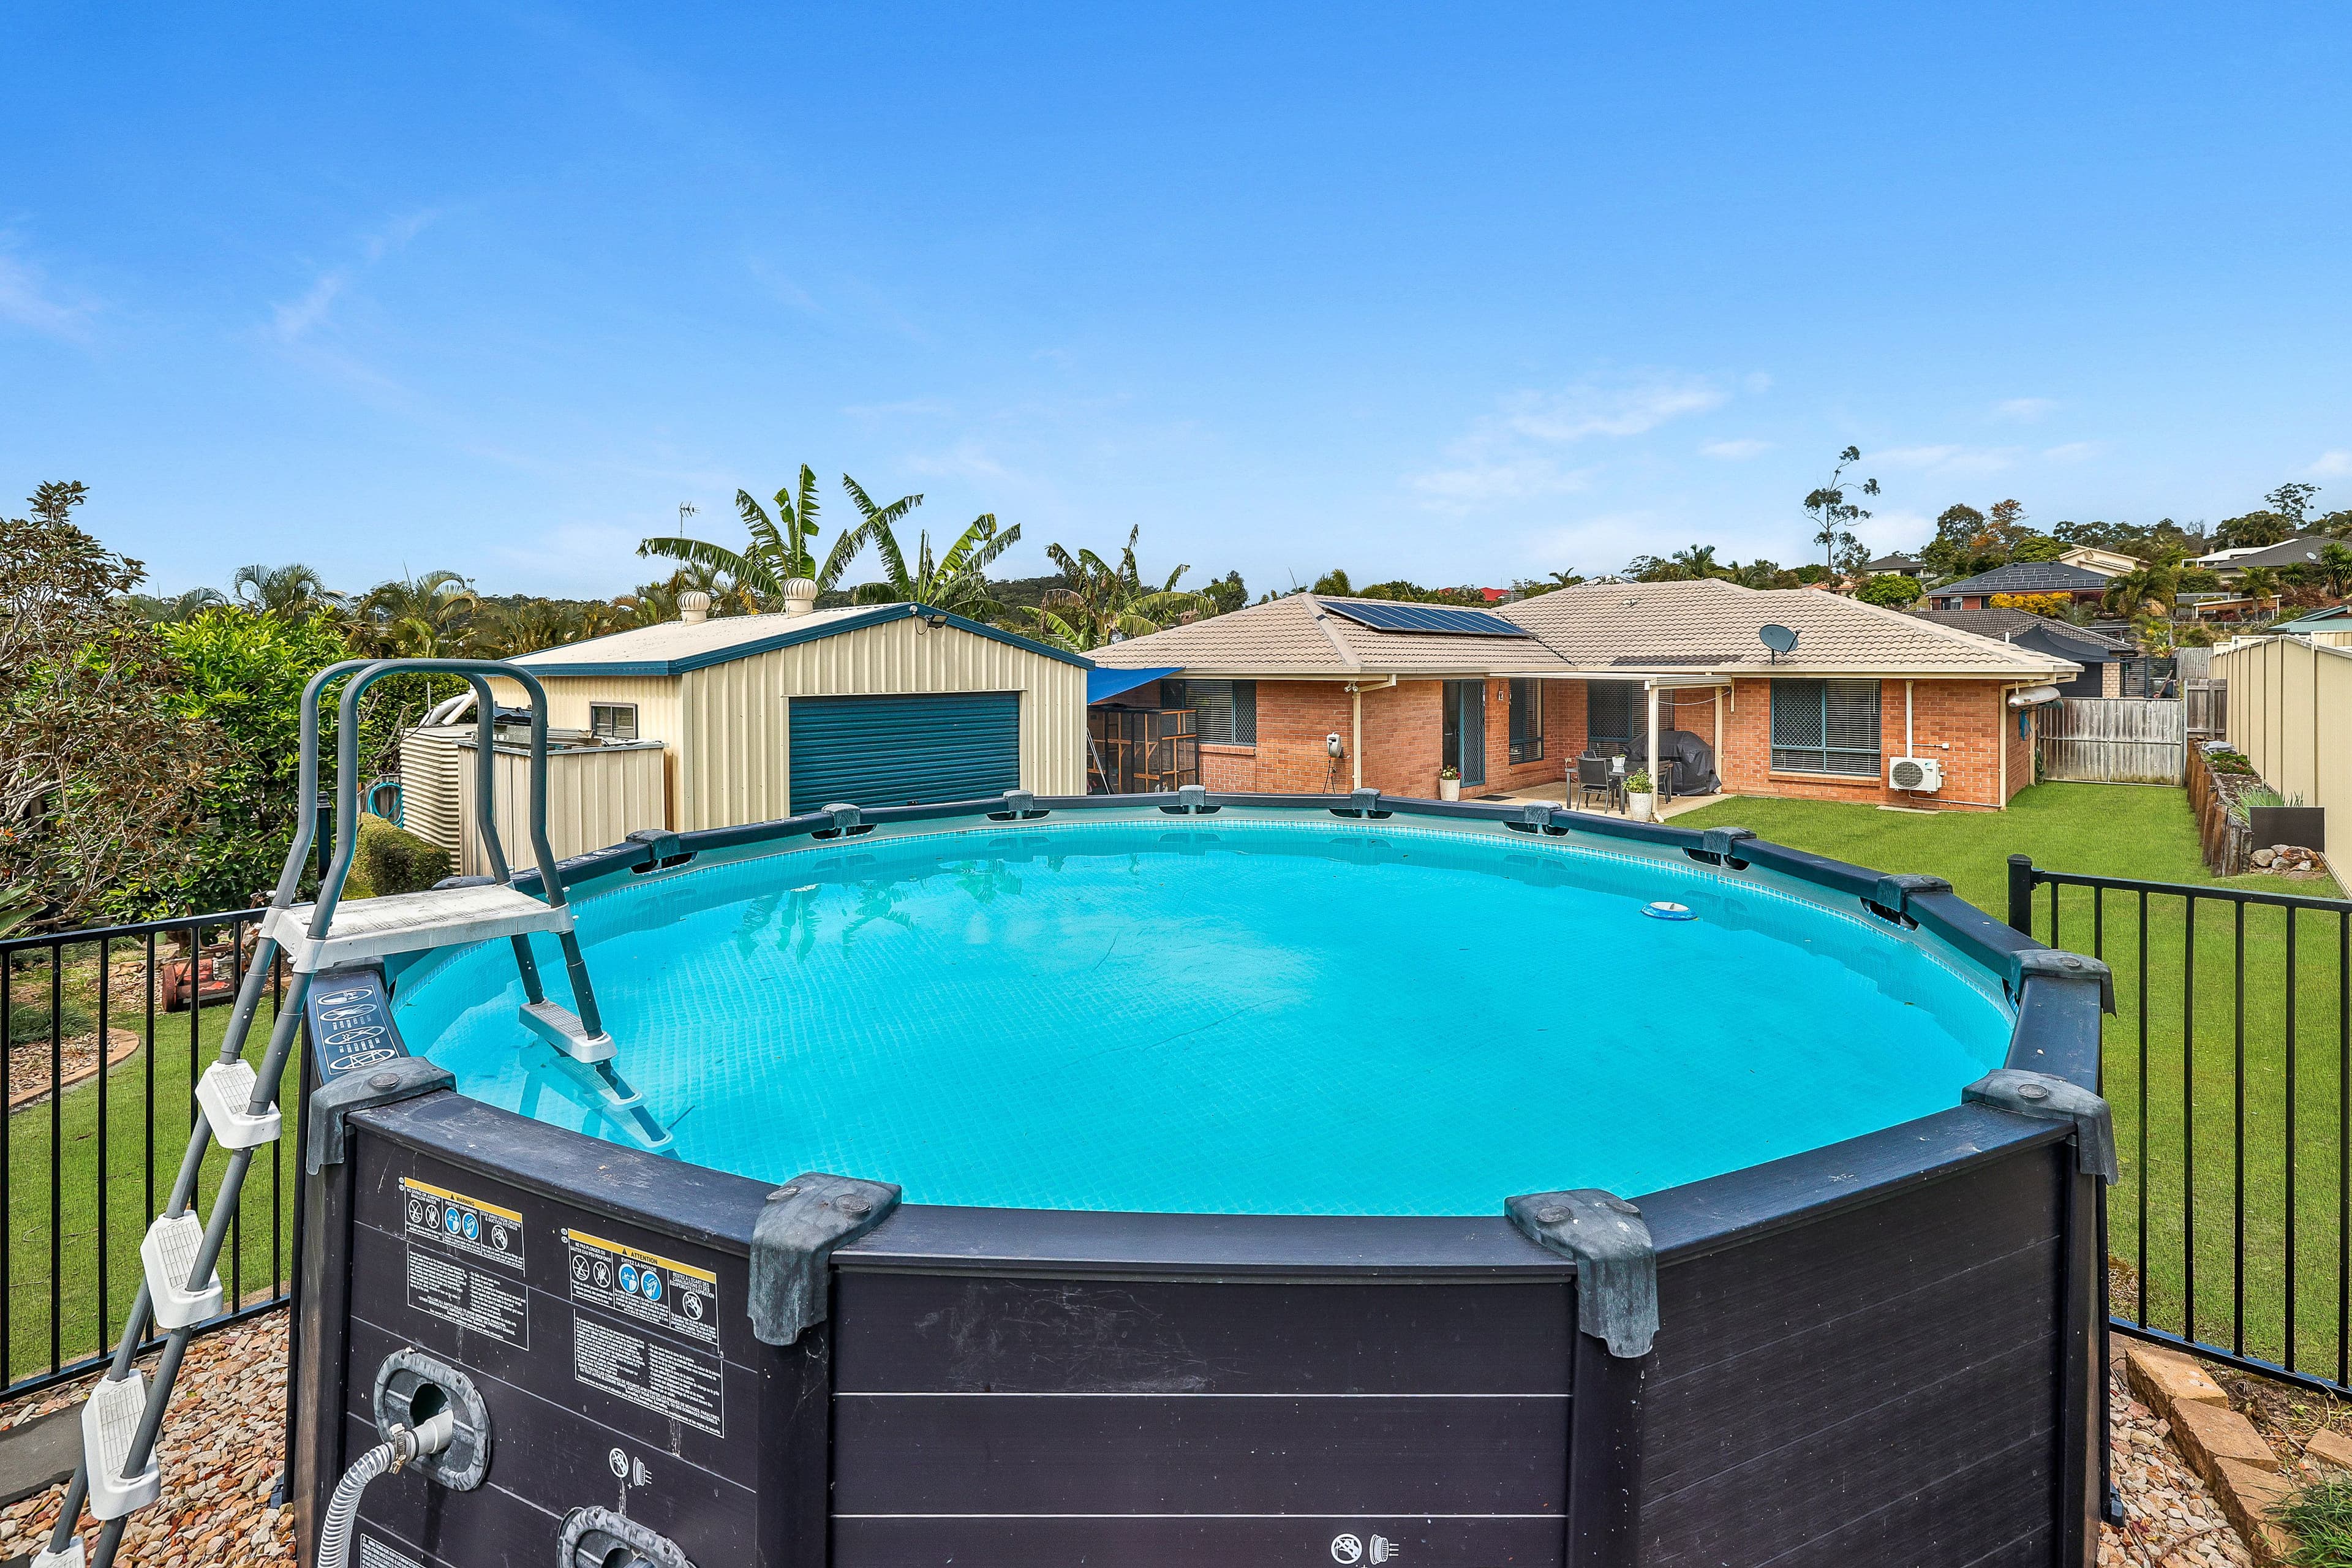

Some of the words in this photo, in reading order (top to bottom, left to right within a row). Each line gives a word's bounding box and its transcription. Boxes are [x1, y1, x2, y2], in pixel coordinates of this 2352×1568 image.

[456, 1197, 474, 1206] WARNING
[459, 1205, 477, 1214] DROWNING
[595, 1253, 611, 1263] PROFONDE
[630, 1252, 657, 1264] ATTENTION
[640, 1263, 657, 1273] NOYADE
[673, 1276, 697, 1288] CANALISATIONS
